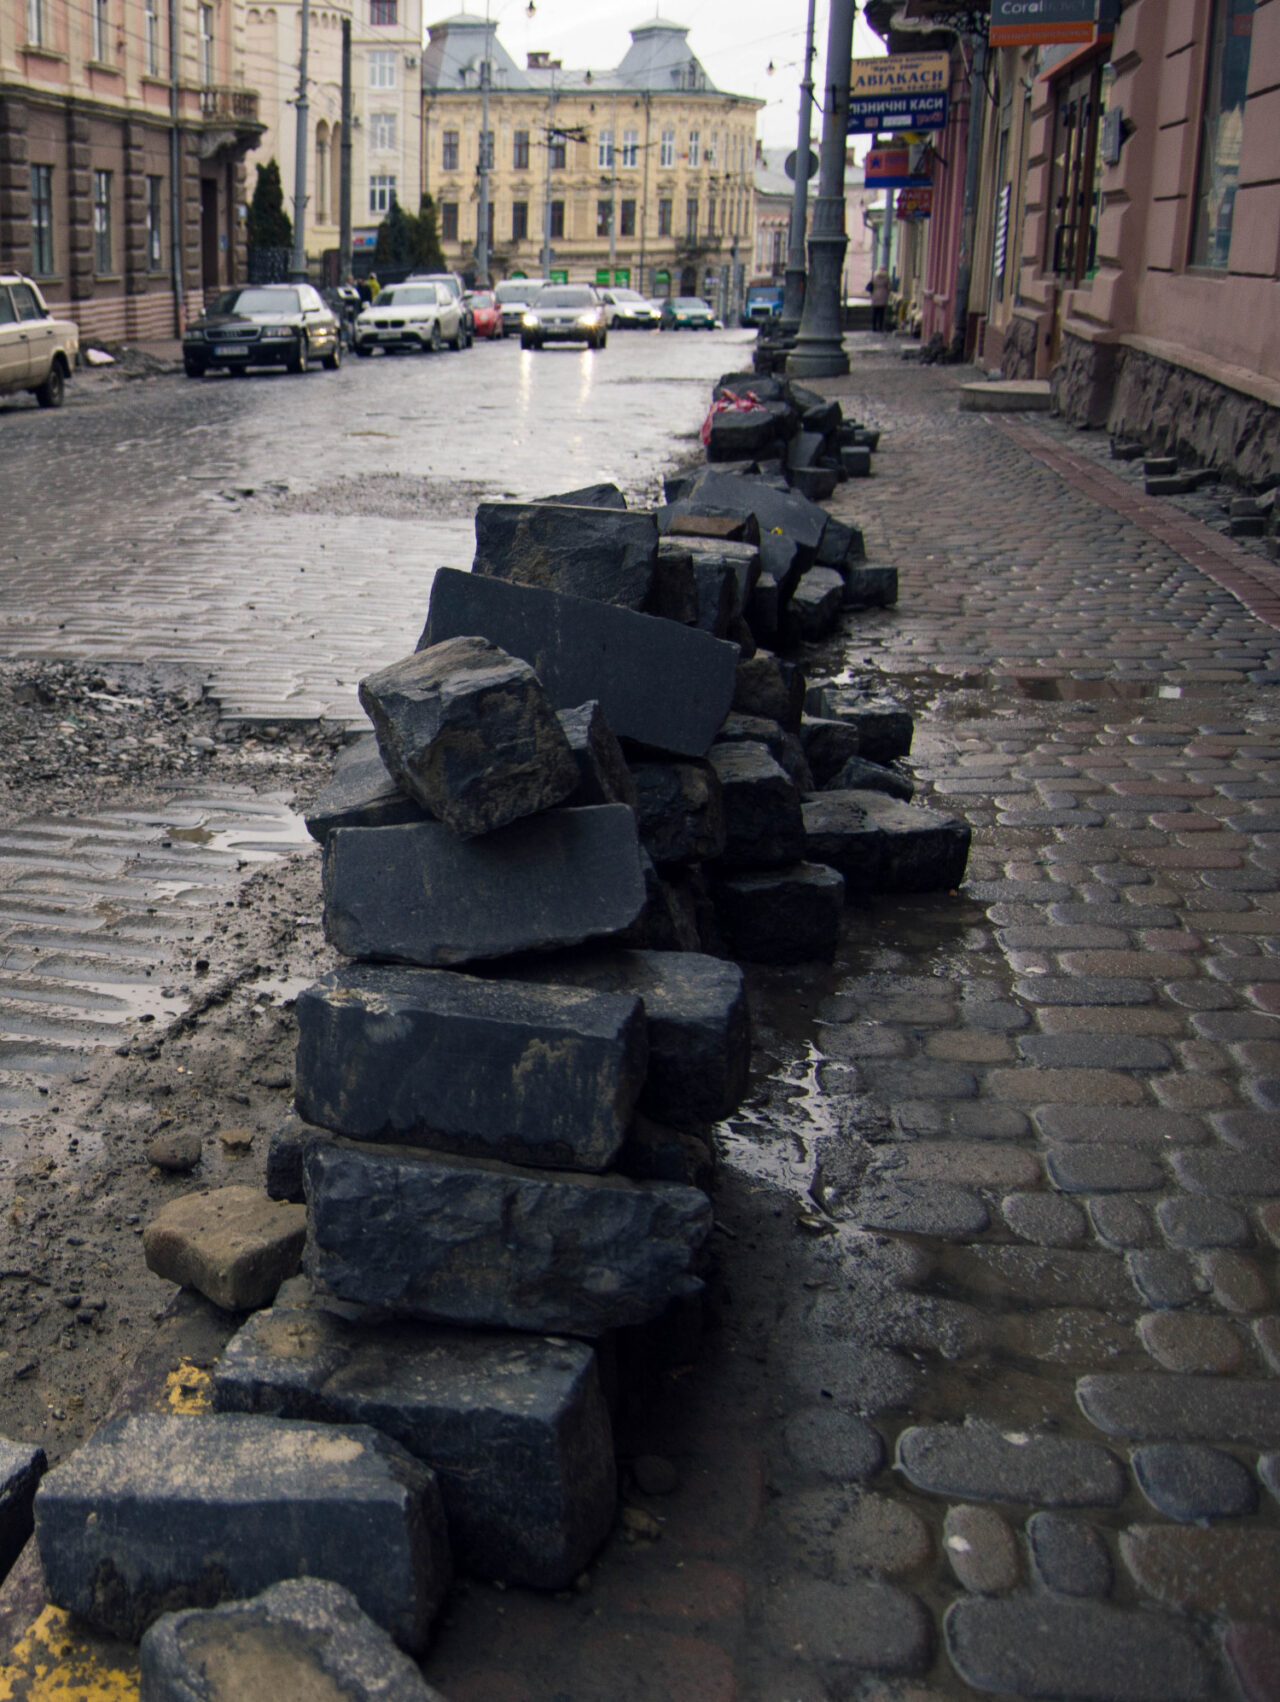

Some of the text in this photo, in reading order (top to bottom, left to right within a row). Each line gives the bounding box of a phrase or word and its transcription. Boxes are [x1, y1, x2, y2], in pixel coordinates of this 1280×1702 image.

[1001, 0, 1044, 15] Coral
[855, 70, 944, 87] АВІАКАСИ
[849, 97, 944, 115] ЛІЗНИЧНІ КАСИ
